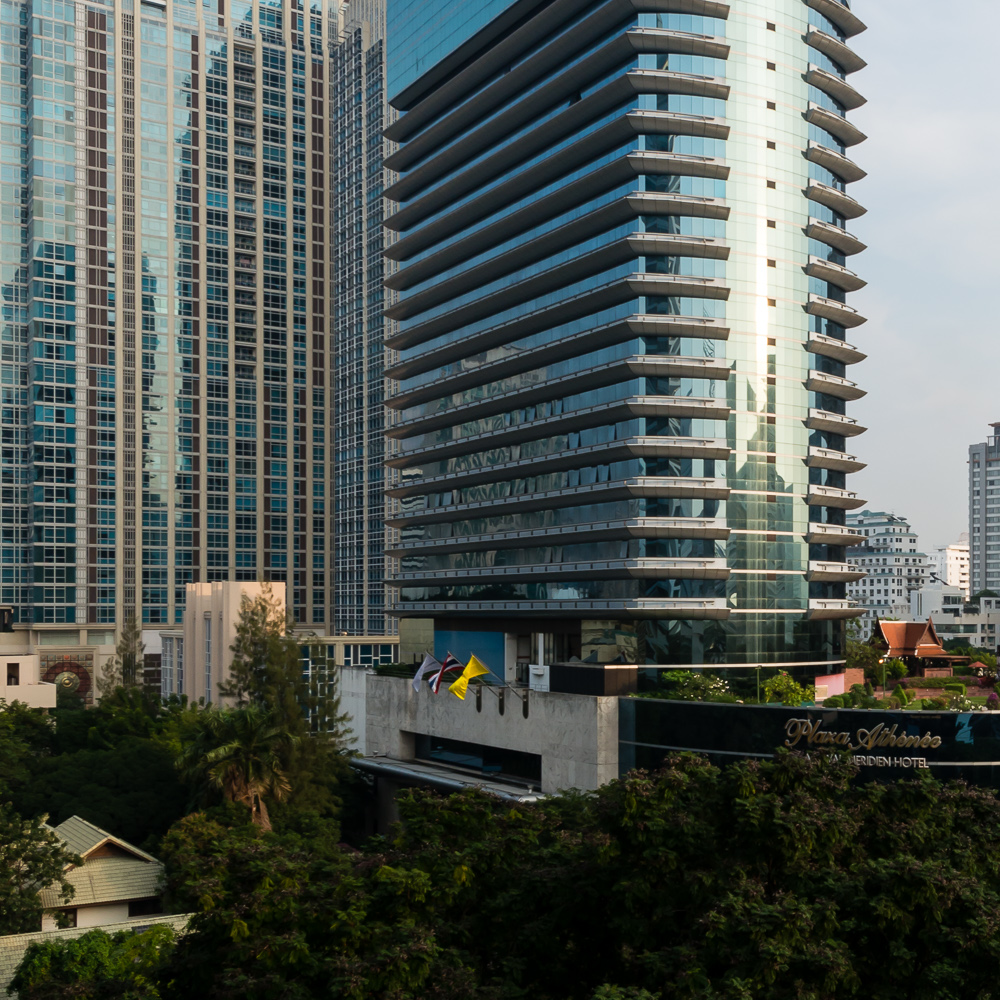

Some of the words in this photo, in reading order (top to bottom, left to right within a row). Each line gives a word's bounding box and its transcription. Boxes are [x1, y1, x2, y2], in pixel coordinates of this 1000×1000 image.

[785, 718, 850, 747] Plaza
[848, 722, 942, 750] Athénée
[894, 757, 929, 768] HOTEL
